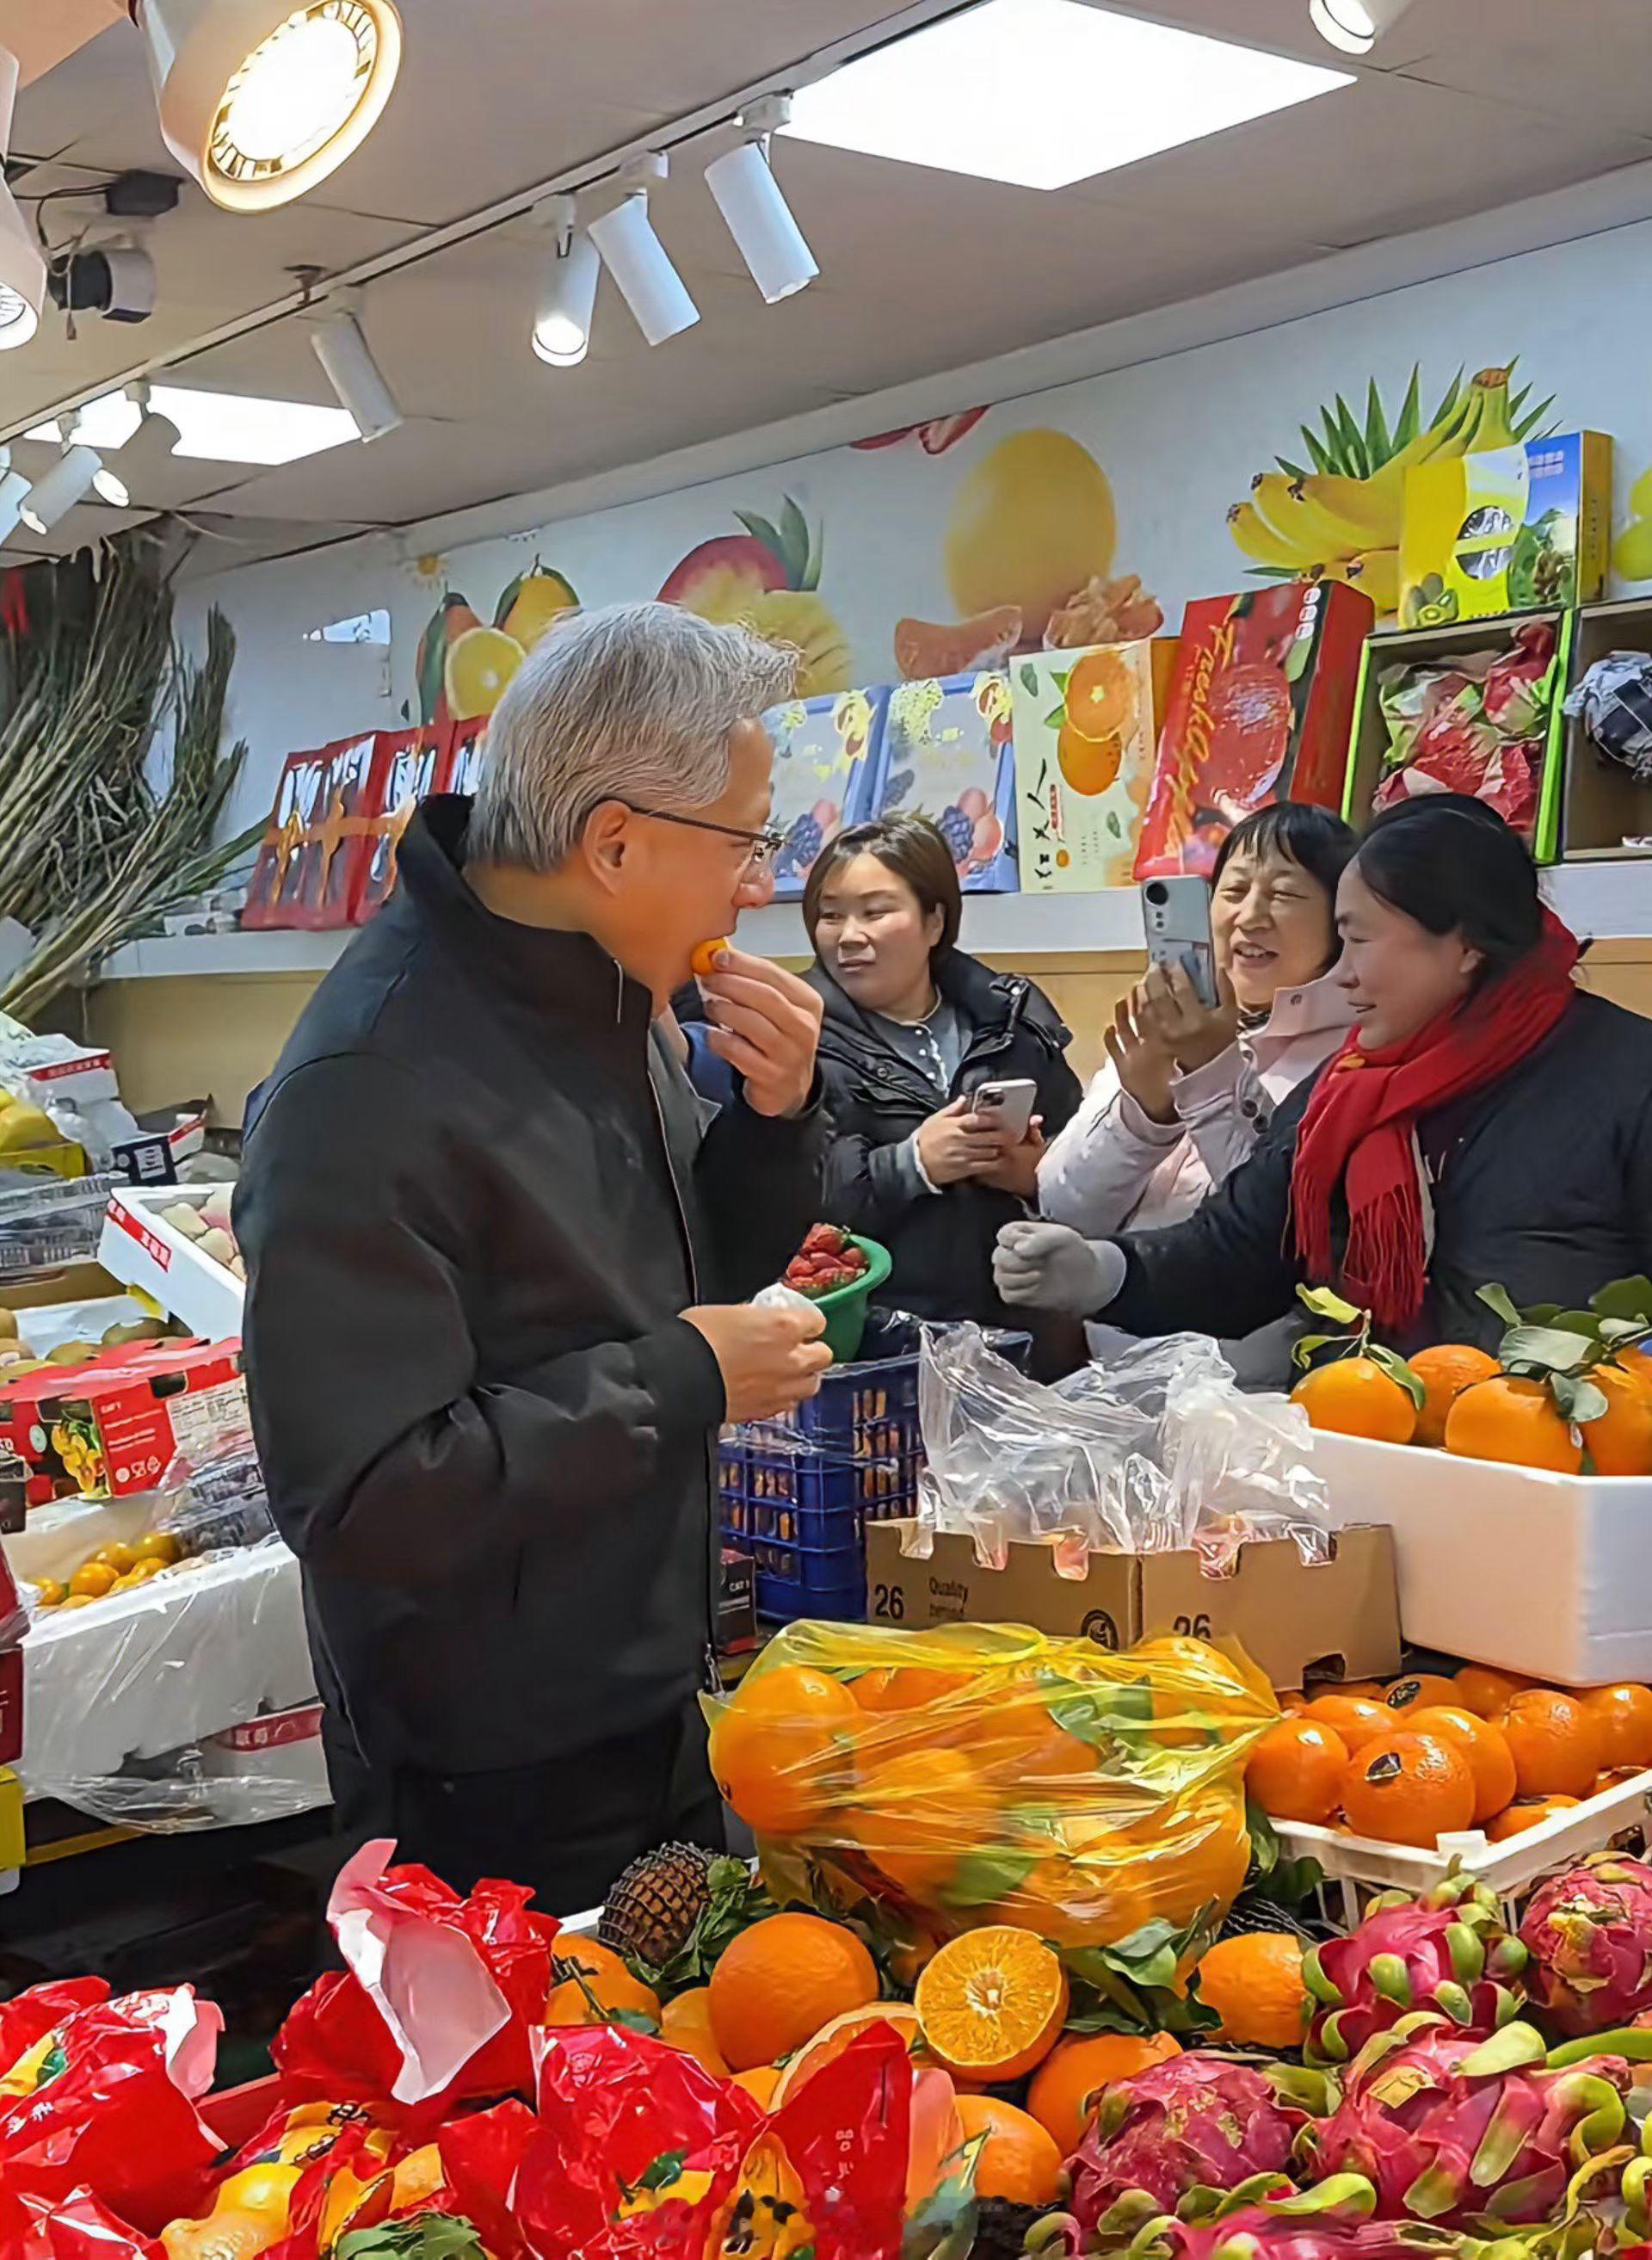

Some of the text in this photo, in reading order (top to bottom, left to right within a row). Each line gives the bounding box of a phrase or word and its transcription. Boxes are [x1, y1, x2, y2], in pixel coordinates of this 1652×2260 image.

[874, 1584, 903, 1620] 26
[928, 1576, 969, 1604] Quality
[1174, 1614, 1211, 1639] 26
